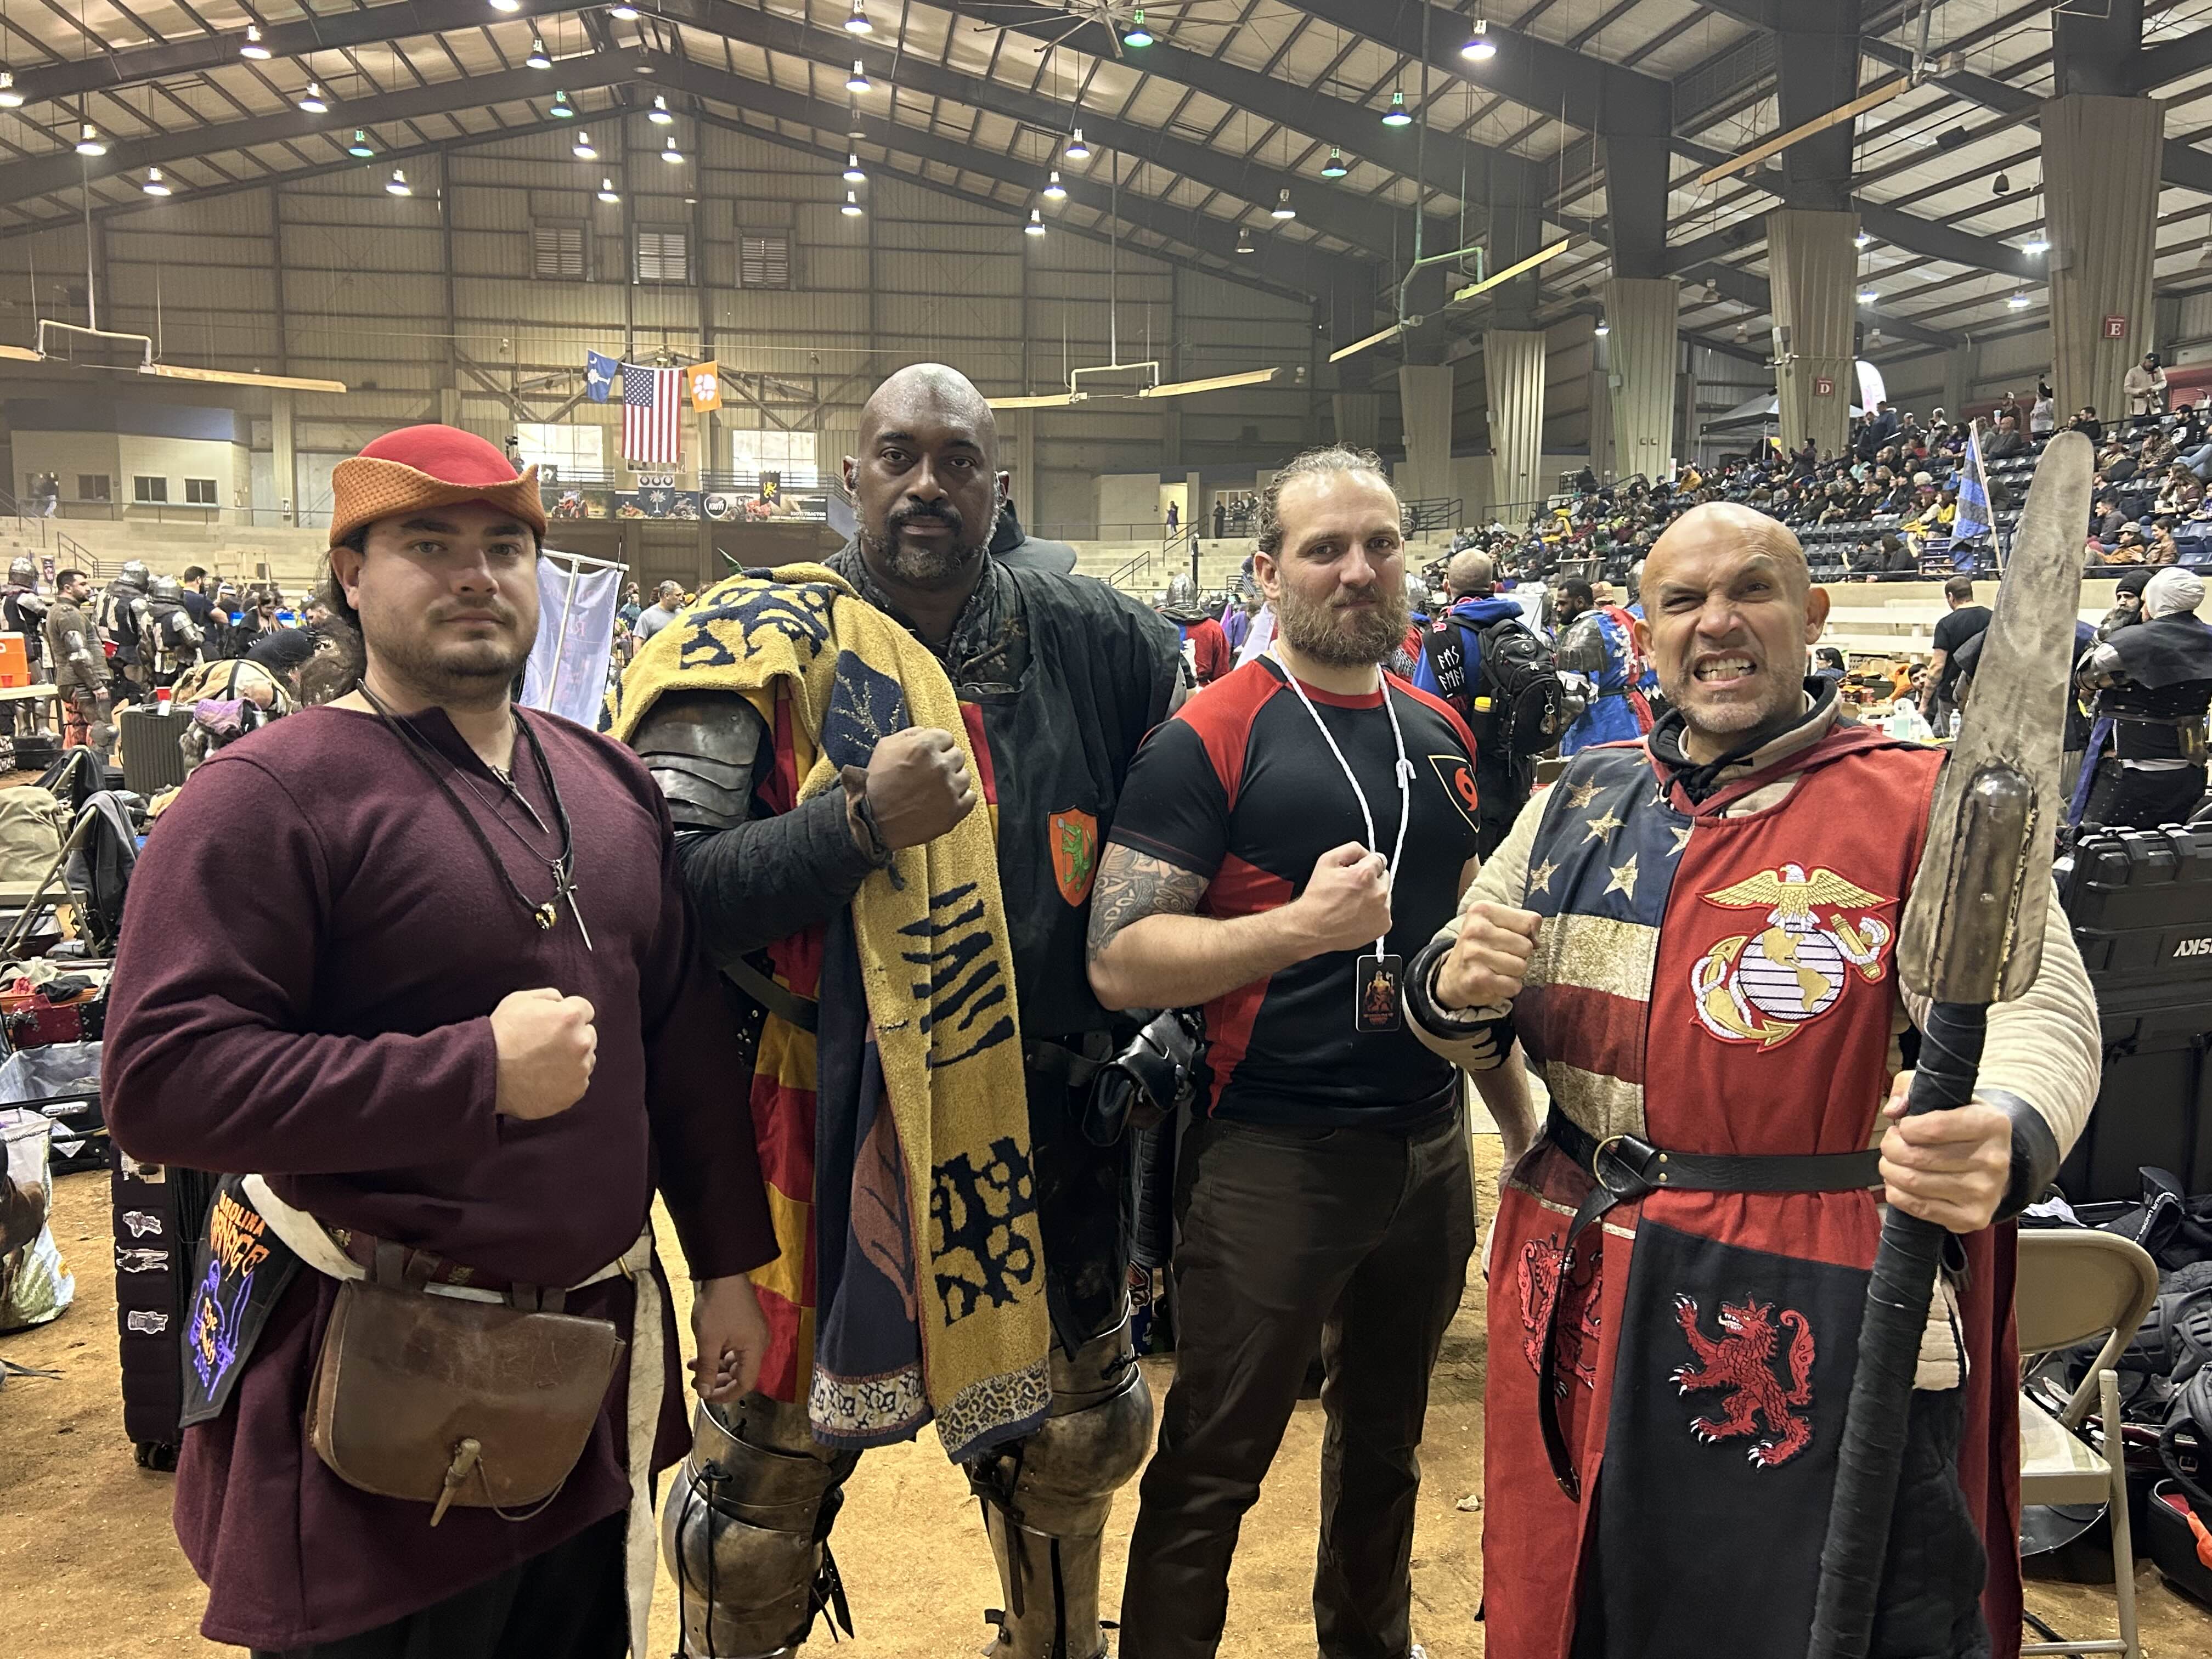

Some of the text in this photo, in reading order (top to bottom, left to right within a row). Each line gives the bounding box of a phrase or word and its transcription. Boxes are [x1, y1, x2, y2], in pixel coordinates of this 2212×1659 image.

[2111, 323, 2121, 335] E
[1820, 383, 1830, 393] D
[2172, 938, 2212, 957] SKY
[211, 1205, 270, 1282] ARNAGE
